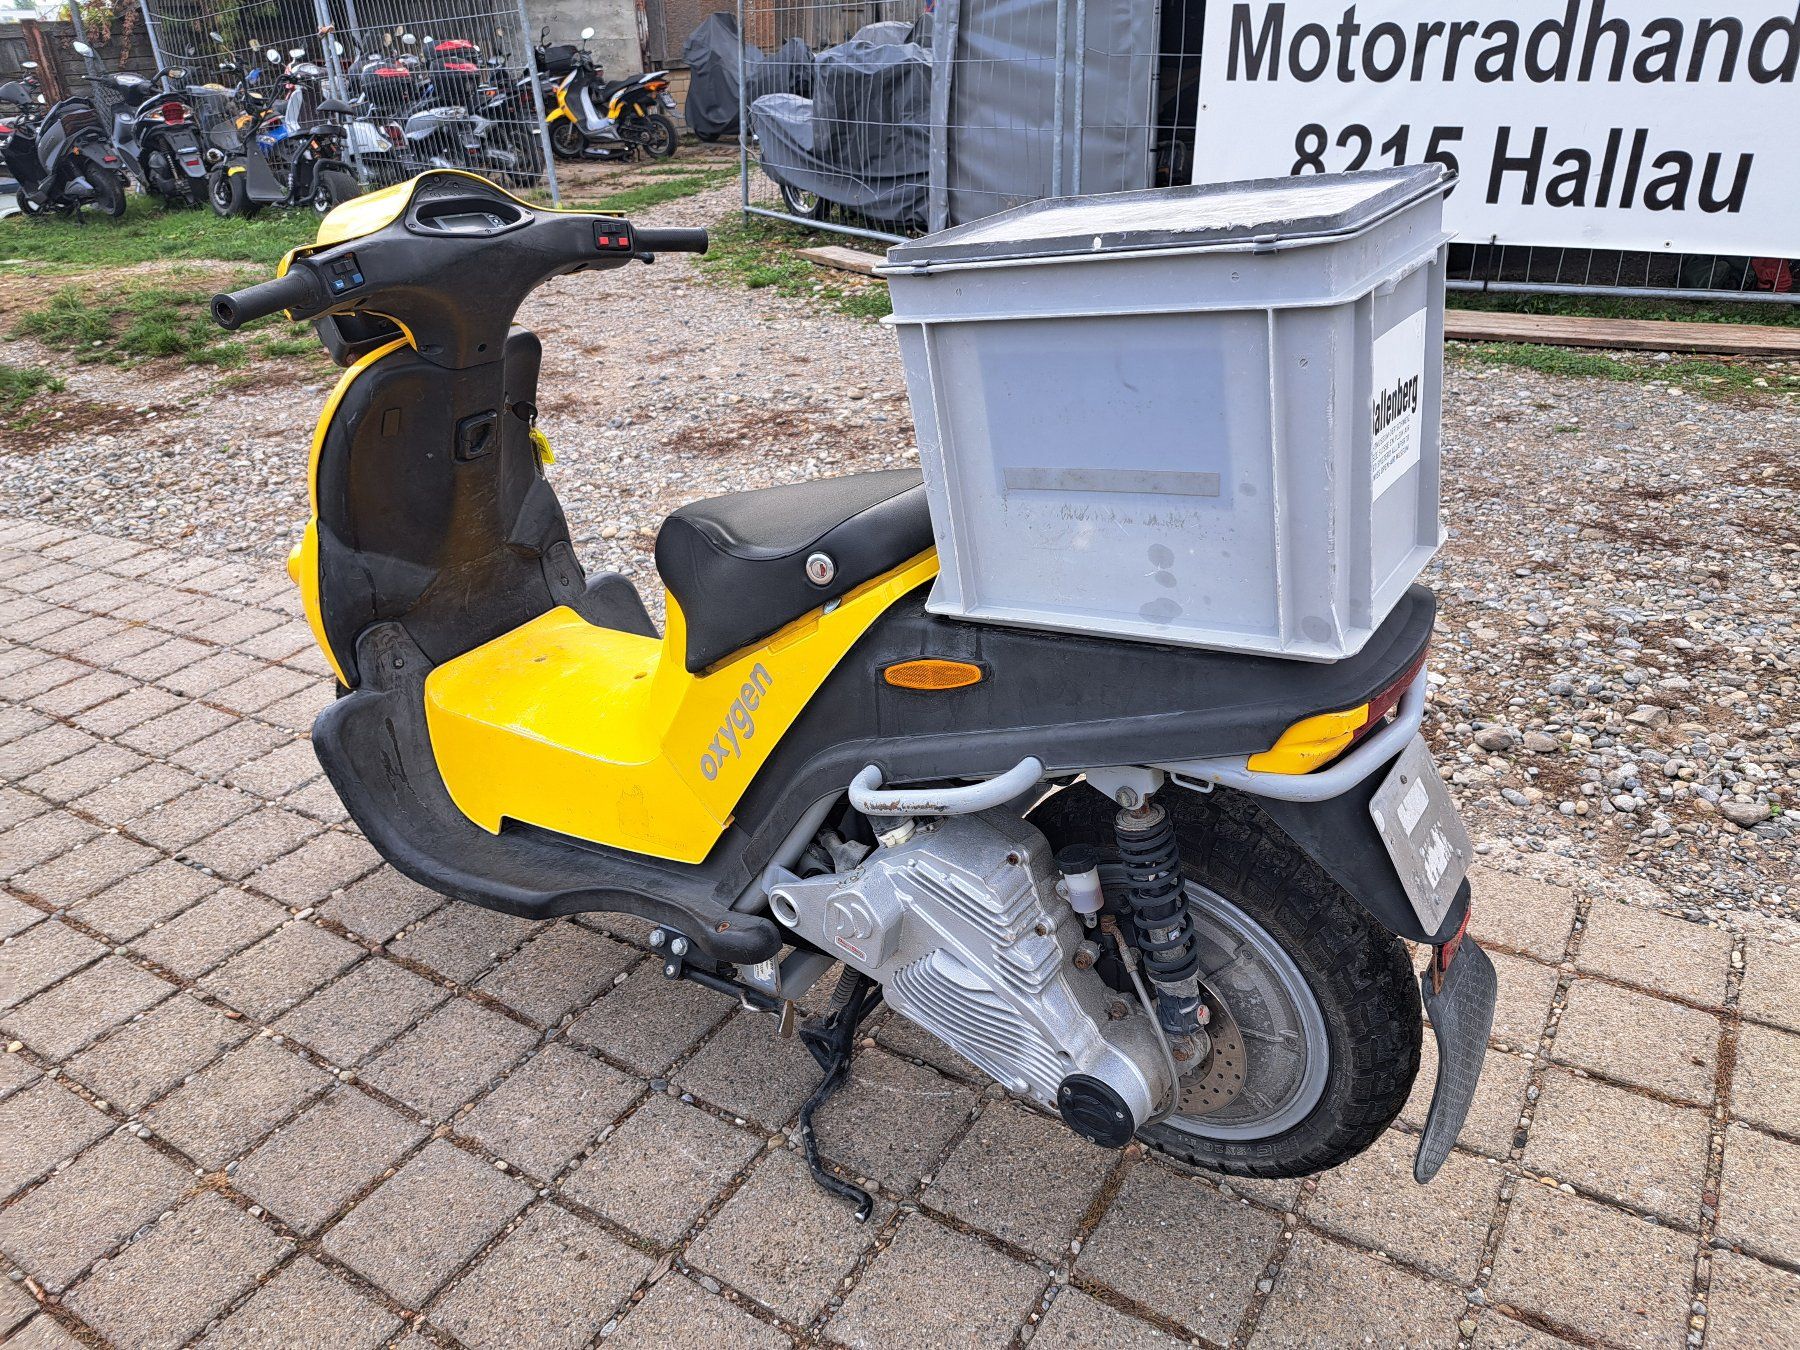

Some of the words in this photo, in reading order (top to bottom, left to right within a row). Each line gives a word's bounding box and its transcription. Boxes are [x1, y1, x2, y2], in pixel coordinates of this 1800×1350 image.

[1226, 0, 1800, 84] Motorradhand
[1485, 126, 1755, 214] Hallau
[700, 662, 773, 781] oxygen
